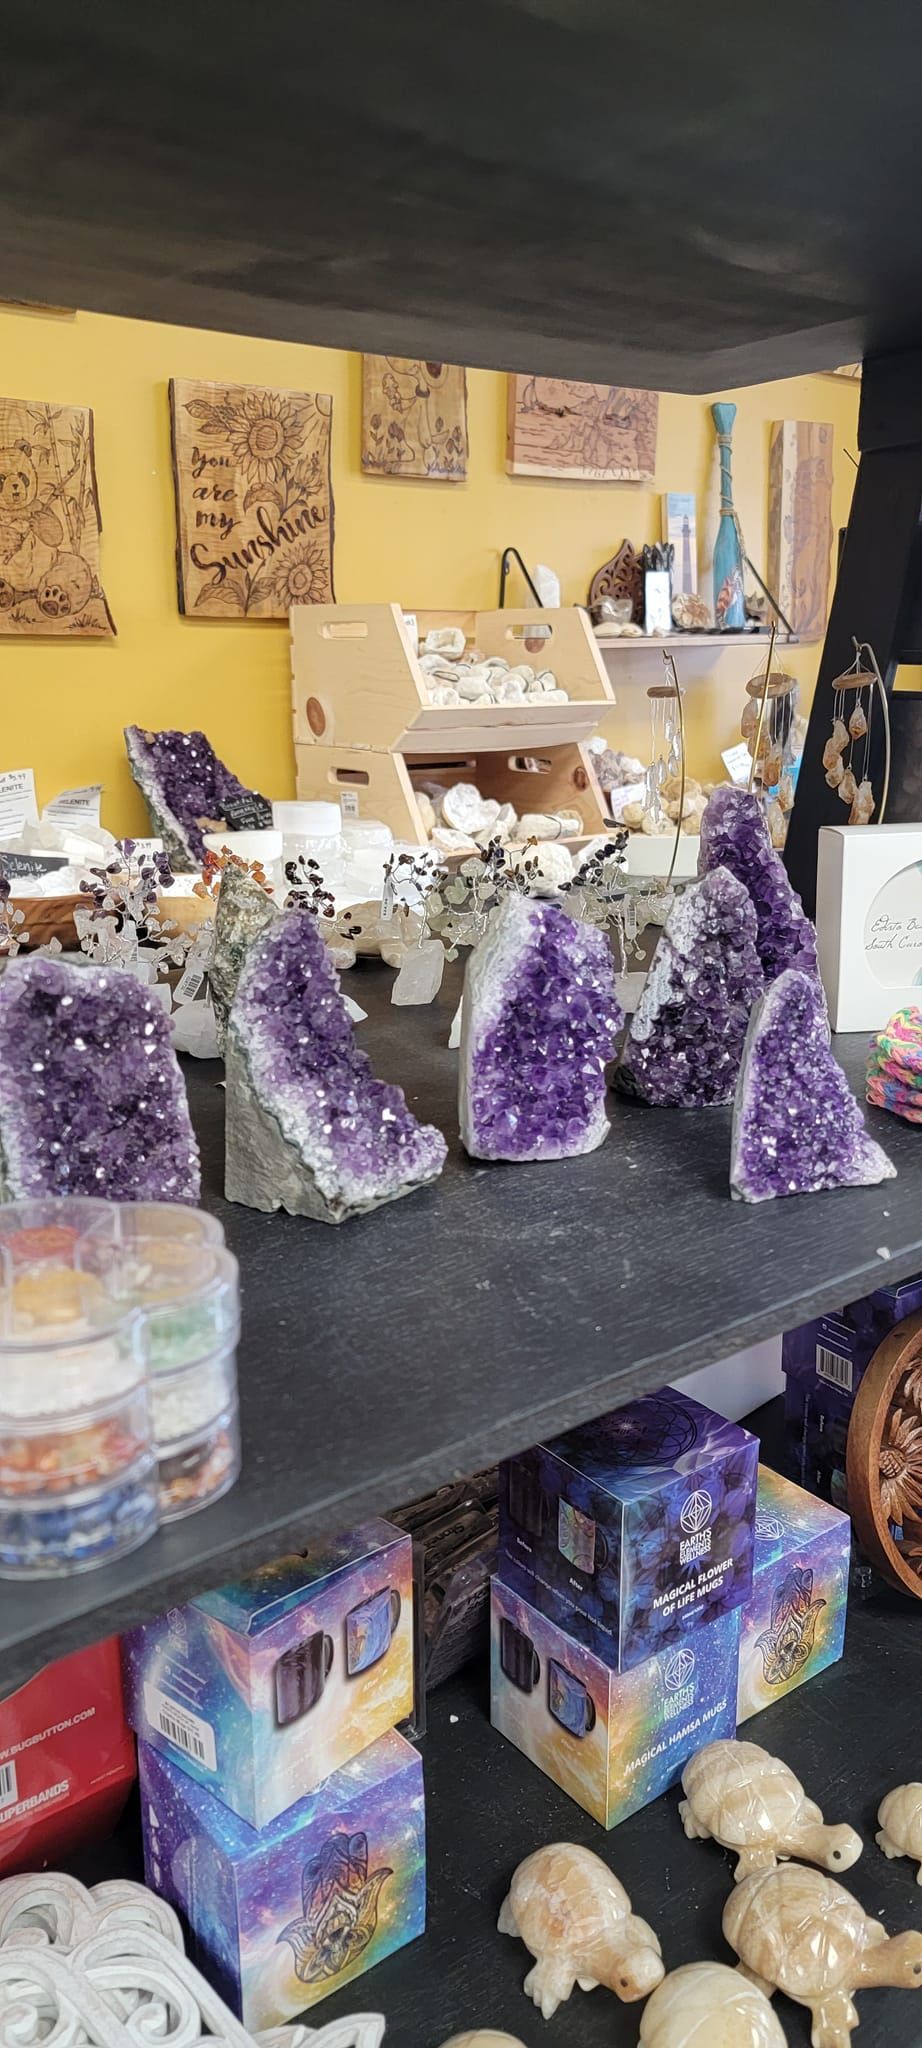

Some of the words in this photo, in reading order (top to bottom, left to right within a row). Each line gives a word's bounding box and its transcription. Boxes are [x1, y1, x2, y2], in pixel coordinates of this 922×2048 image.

[192, 447, 229, 479] You
[192, 484, 238, 501] are
[196, 510, 241, 540] my
[190, 505, 327, 585] Sunshine
[865, 933, 898, 951] South
[680, 1546, 712, 1566] WELLNESS
[653, 1580, 696, 1609] MAGICAL
[697, 1558, 734, 1585] FLOWER
[662, 1603, 676, 1617] OF
[677, 1591, 695, 1610] LIFE
[696, 1576, 724, 1599] MUGS
[623, 1742, 667, 1777] MAGICAL
[668, 1718, 701, 1746] HAMSA
[702, 1698, 728, 1723] MUGS
[0, 1779, 69, 1823] UPERBANDS
